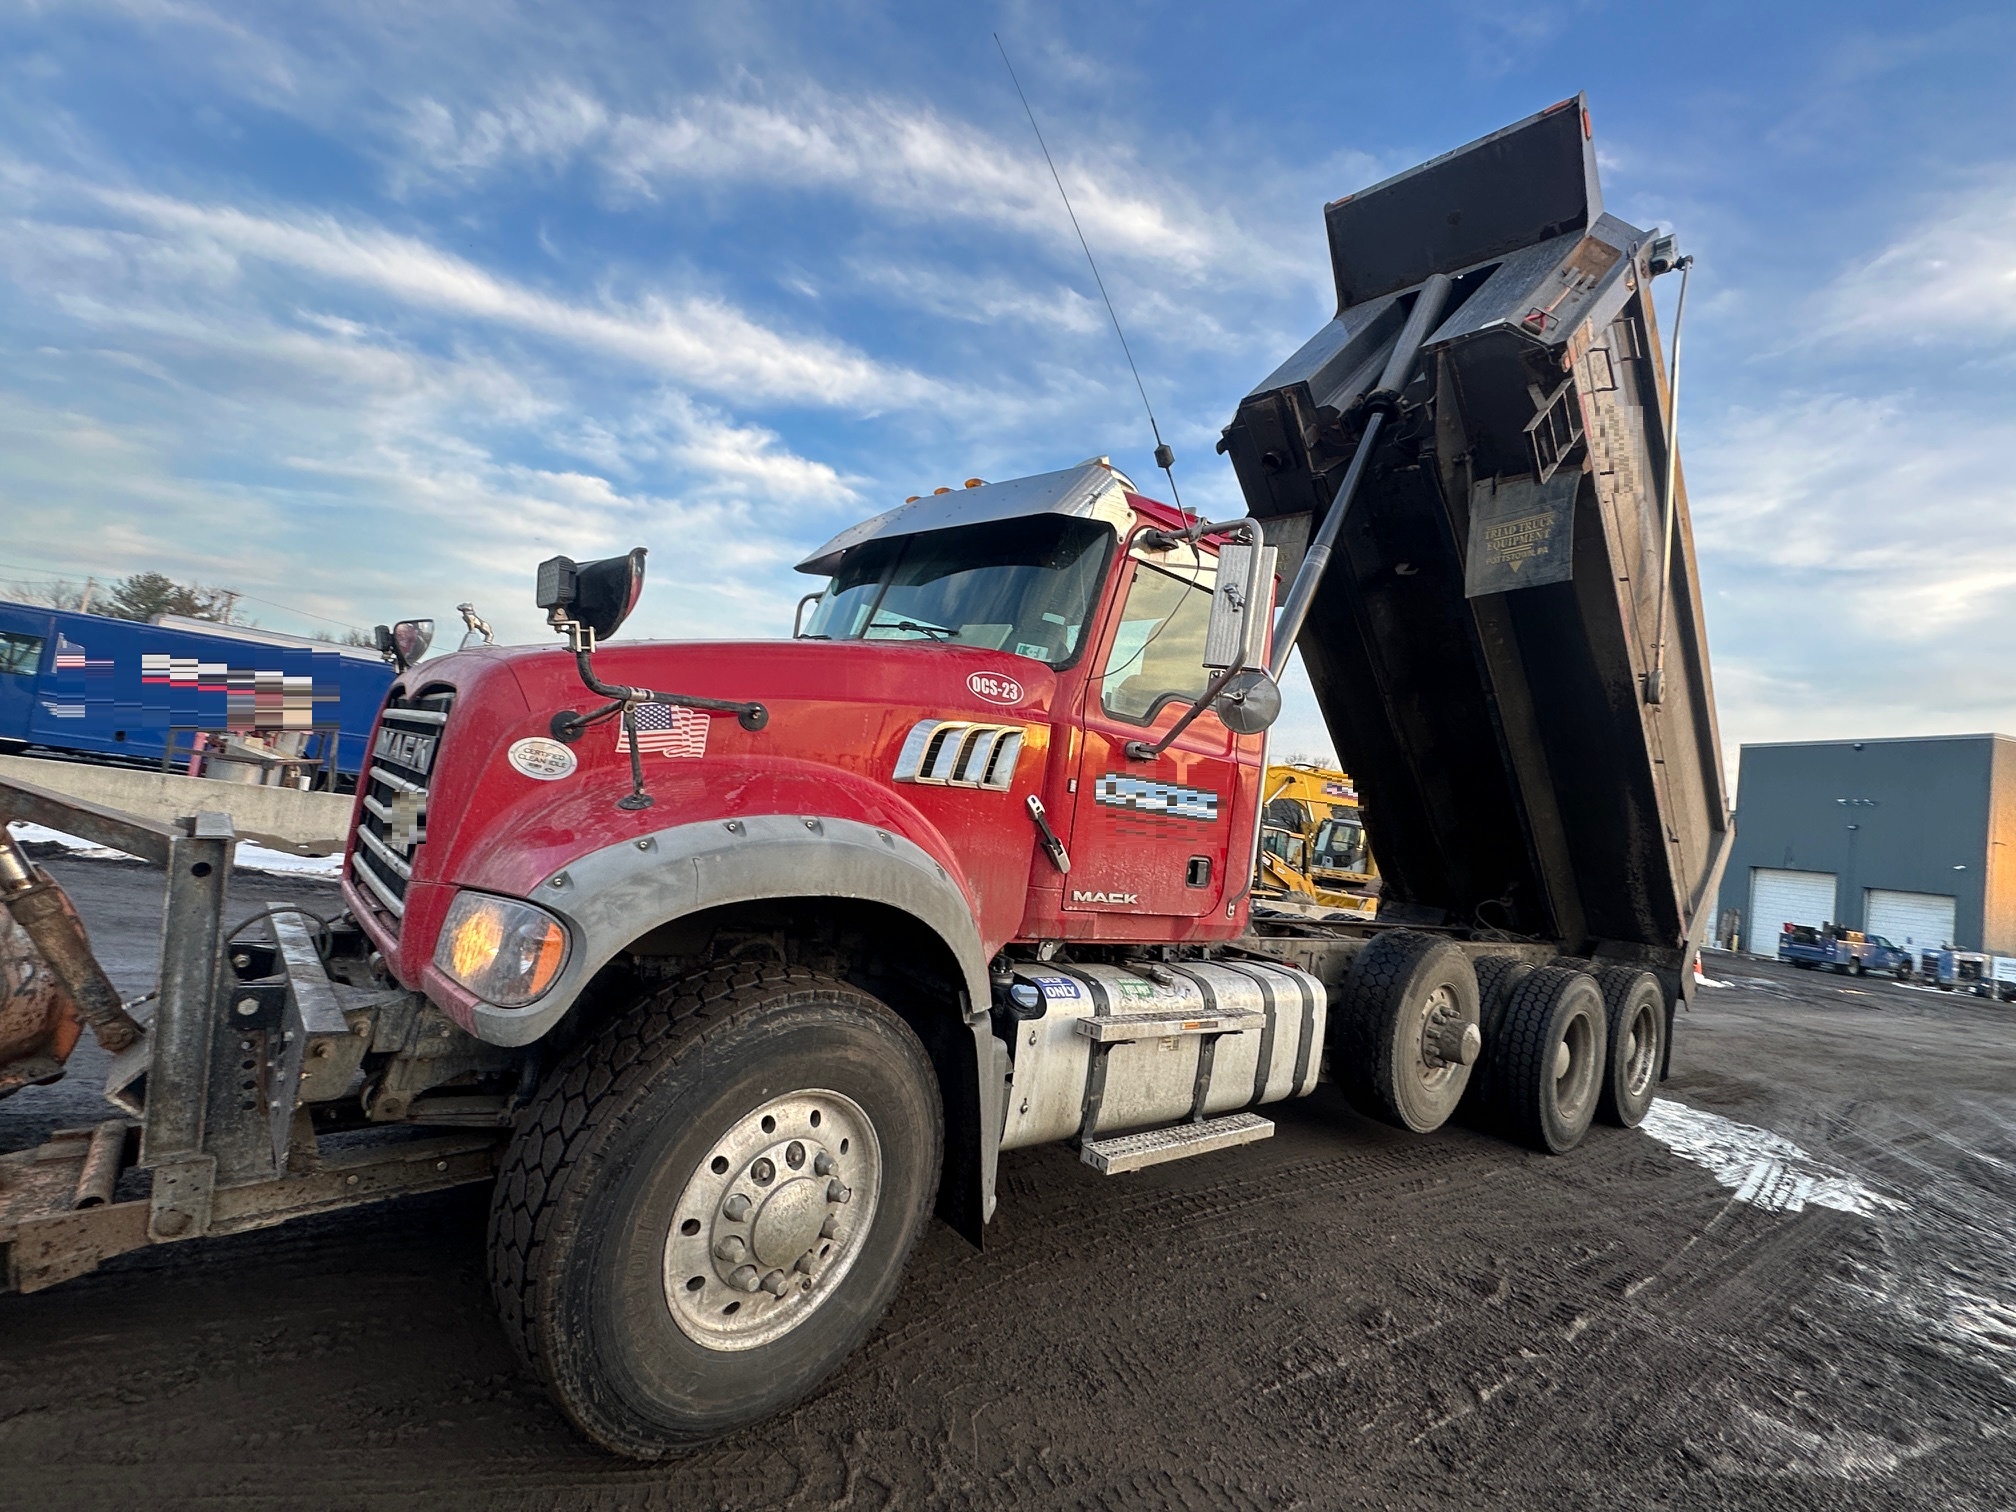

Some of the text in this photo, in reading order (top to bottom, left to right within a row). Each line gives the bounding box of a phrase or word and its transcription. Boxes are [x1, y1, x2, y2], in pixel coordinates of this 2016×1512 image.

[1486, 516, 1553, 540] TRIAD TRUCK
[1487, 529, 1551, 550] EQUIPMENT
[972, 676, 1018, 700] OCS-23
[378, 730, 432, 768] MACK
[523, 747, 566, 761] CERTIFIED
[517, 753, 547, 764] CLEAN
[548, 760, 568, 769] IDLE
[1072, 890, 1138, 904] MACK
[1046, 984, 1076, 998] ONLY
